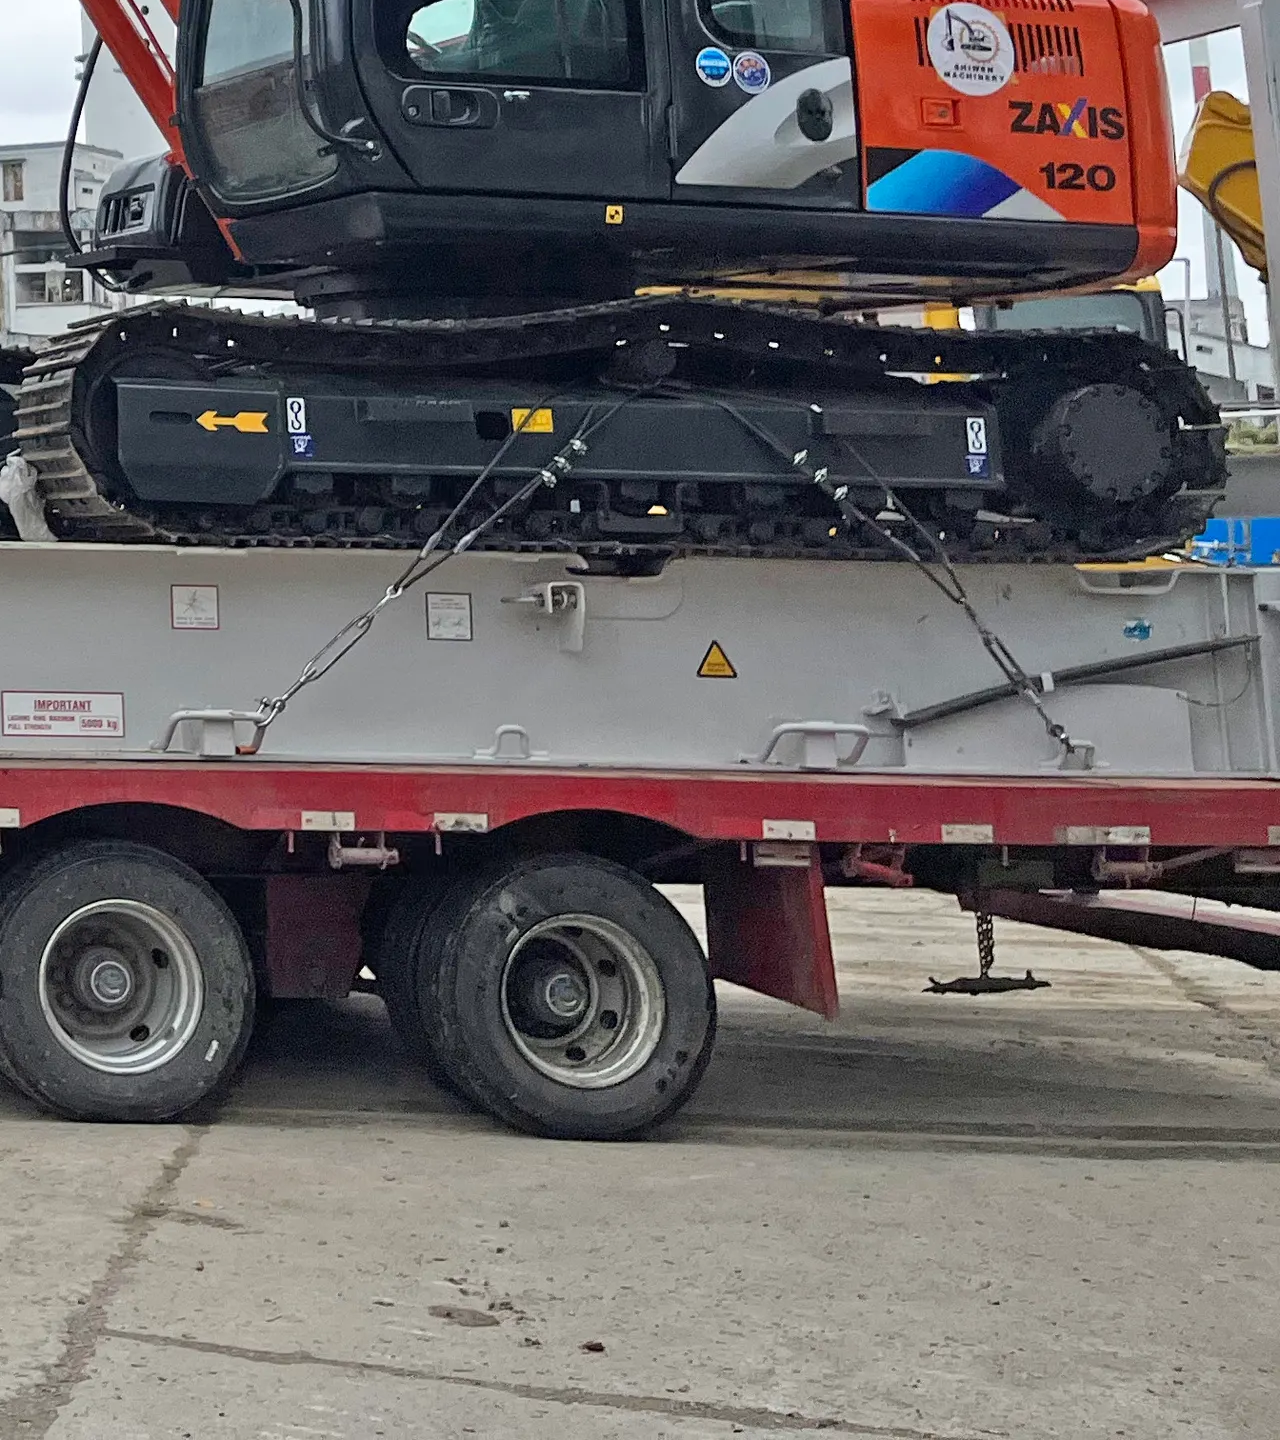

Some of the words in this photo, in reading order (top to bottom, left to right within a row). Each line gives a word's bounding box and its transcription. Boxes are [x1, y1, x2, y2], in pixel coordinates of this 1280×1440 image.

[1008, 96, 1125, 140] ZAXIS
[1039, 162, 1116, 192] 120
[34, 700, 92, 711] IMPORTANT
[107, 720, 119, 731] kg
